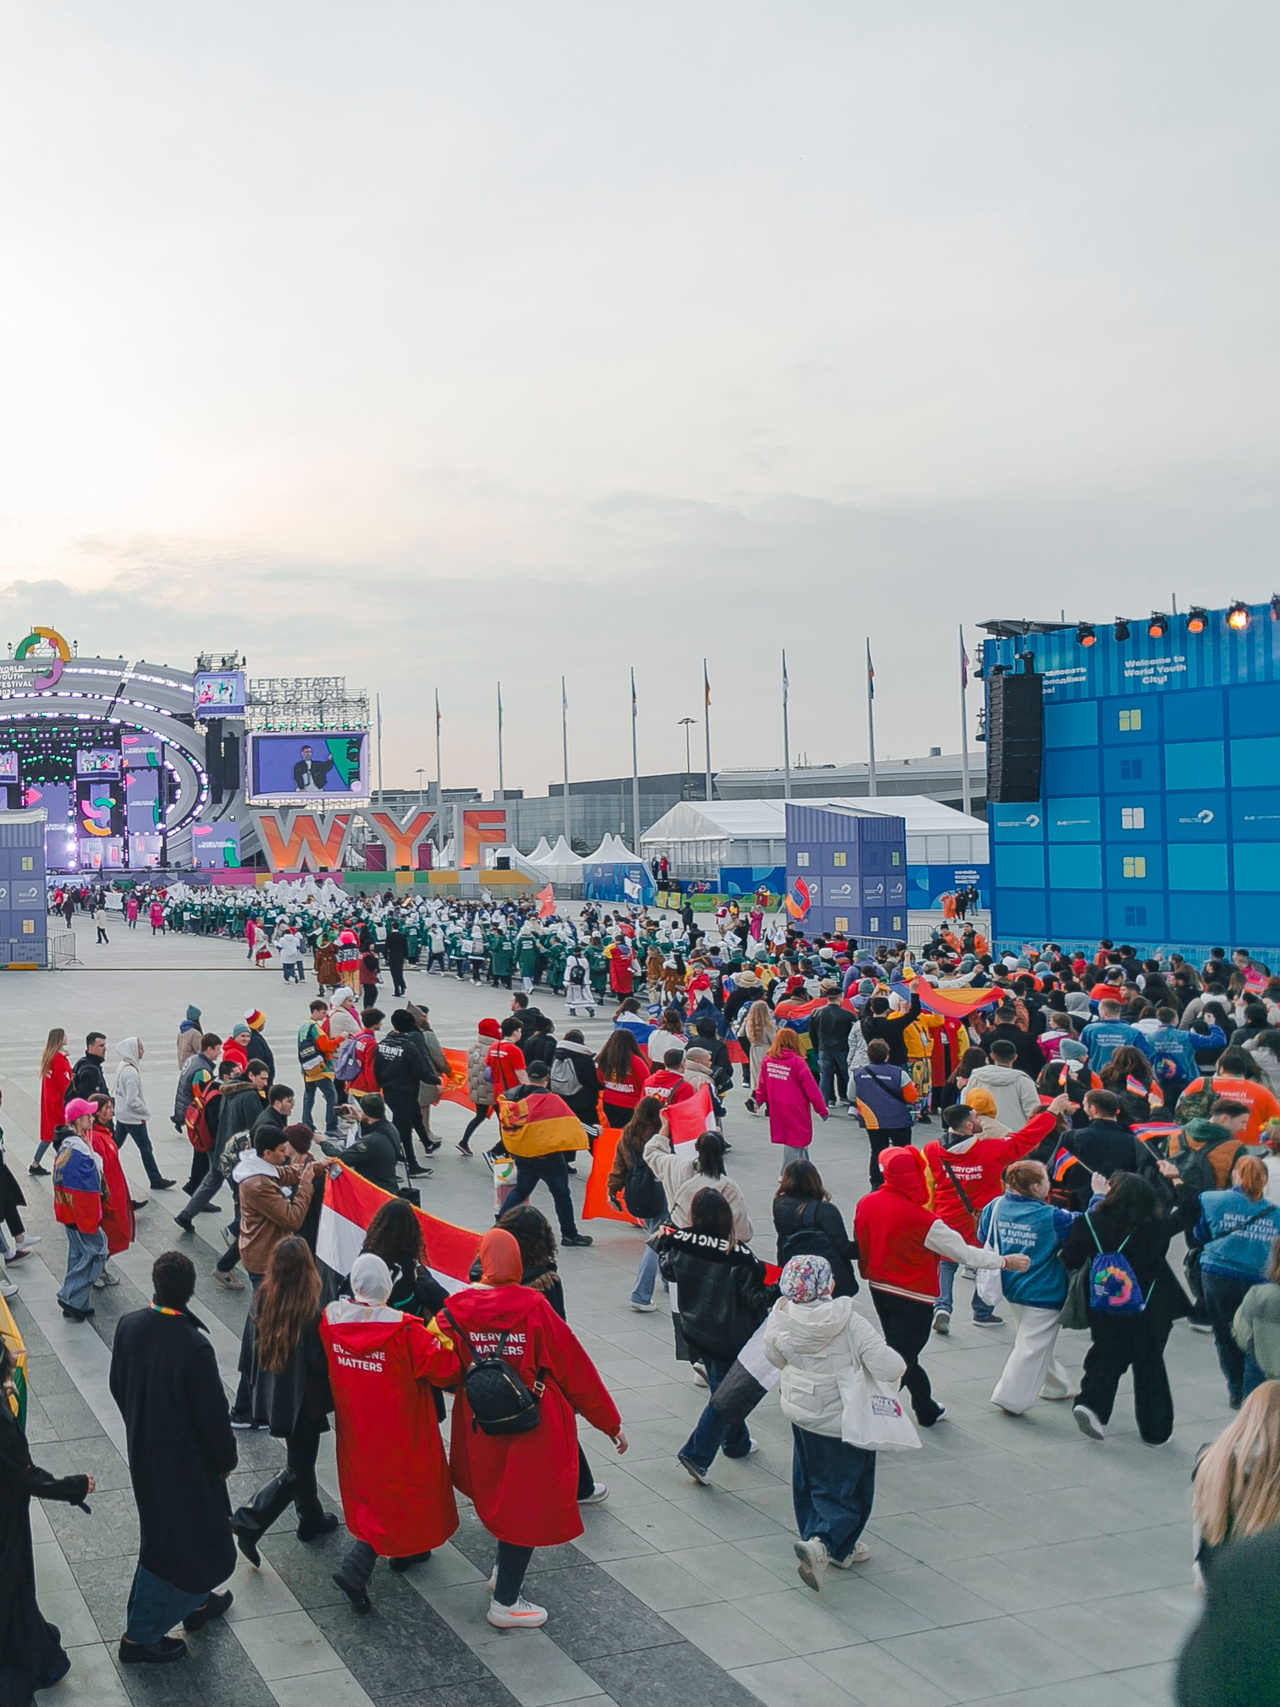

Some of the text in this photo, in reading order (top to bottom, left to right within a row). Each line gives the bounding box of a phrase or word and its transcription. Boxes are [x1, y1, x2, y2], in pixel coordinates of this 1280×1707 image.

[1124, 656, 1171, 668] Welcome
[1045, 667, 1087, 677] аловать
[1124, 664, 1186, 677] World Youth
[249, 676, 341, 689] LET'S START
[1142, 675, 1167, 686] City!
[249, 688, 345, 701] THE FUTURE
[250, 803, 513, 873] WYF
[1001, 1236, 1036, 1247] OGETHER
[337, 1357, 383, 1373] MATTERS
